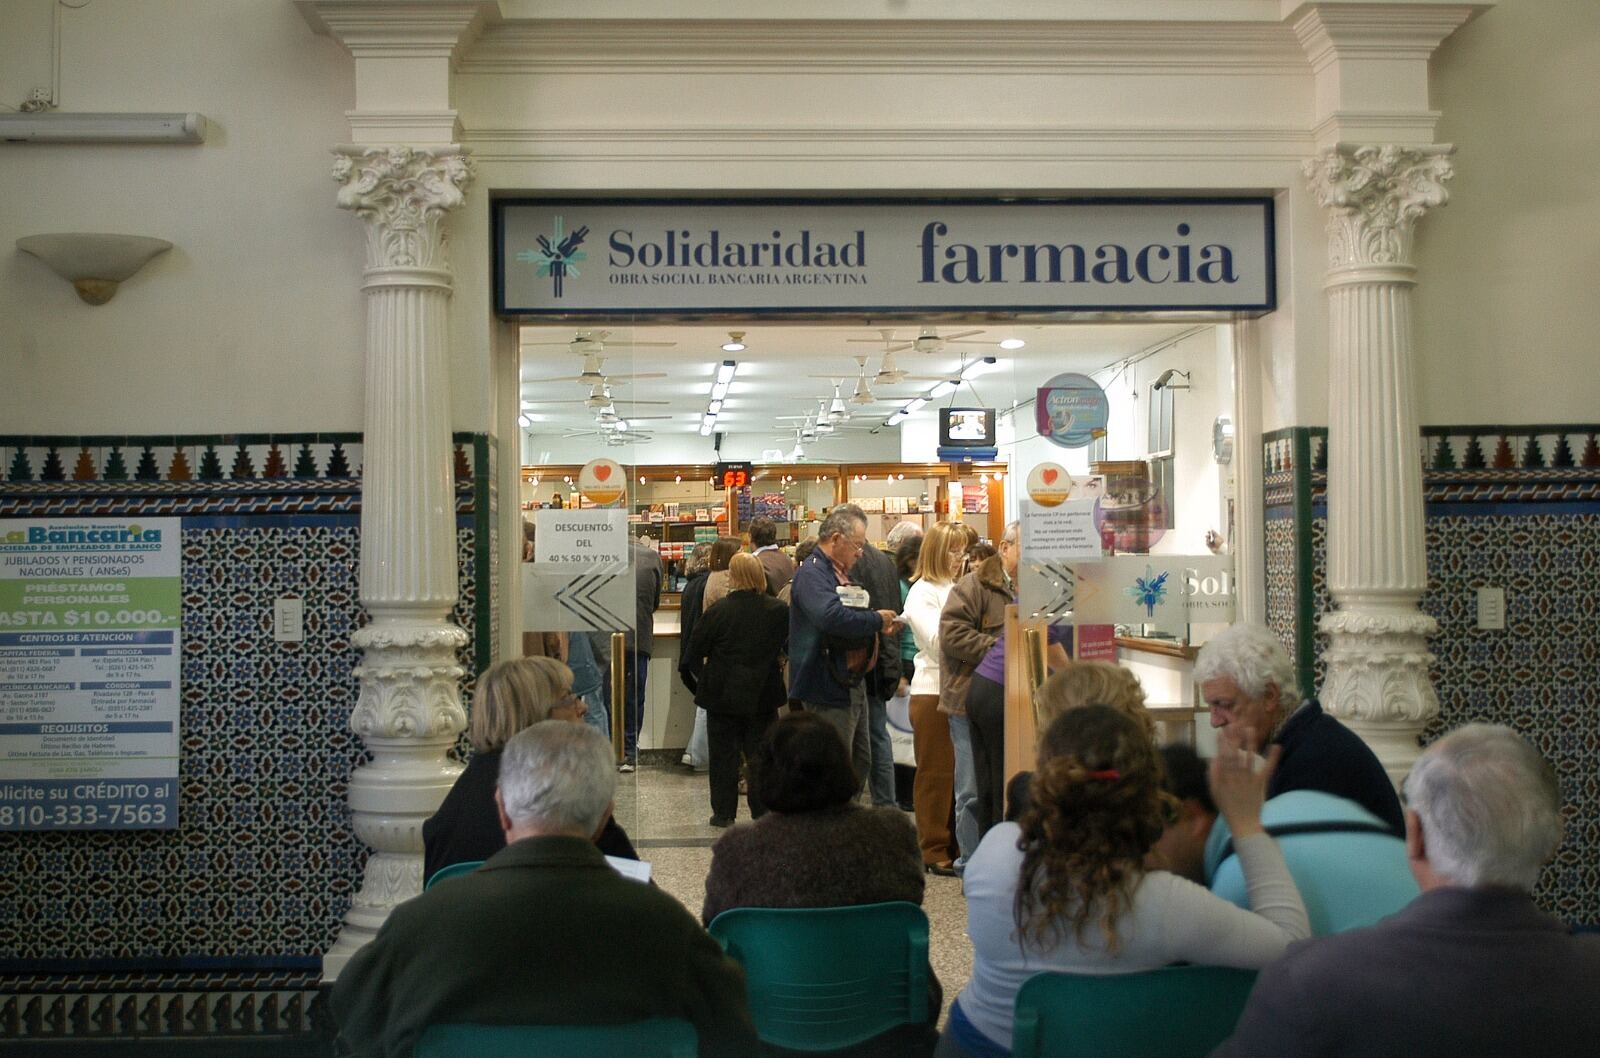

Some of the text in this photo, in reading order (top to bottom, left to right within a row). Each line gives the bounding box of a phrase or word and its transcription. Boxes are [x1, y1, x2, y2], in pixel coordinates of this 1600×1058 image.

[608, 230, 867, 267] Solidaridad
[917, 221, 1239, 284] farmacia
[609, 273, 868, 285] OBRA SOCIAL BANCARIA ARGENTINA
[724, 471, 745, 487] 63
[555, 523, 613, 532] DESCUENTOS
[29, 524, 162, 543] Bancaria
[576, 539, 592, 547] DEL
[5, 555, 144, 565] JUBILADOS Y PENSIONADOS
[549, 554, 620, 562] 40 % 50 % Y 70 %
[20, 567, 84, 576] NACIONALES
[25, 583, 126, 592] PRÉSTAMOS
[23, 594, 129, 605] PERSONALES
[19, 634, 65, 642] CENTROS
[81, 632, 133, 642] ATENCIÓN
[41, 724, 109, 733] REQUISITOS
[50, 788, 68, 800] su
[74, 782, 149, 798] CRÉDITO
[154, 783, 169, 798] al
